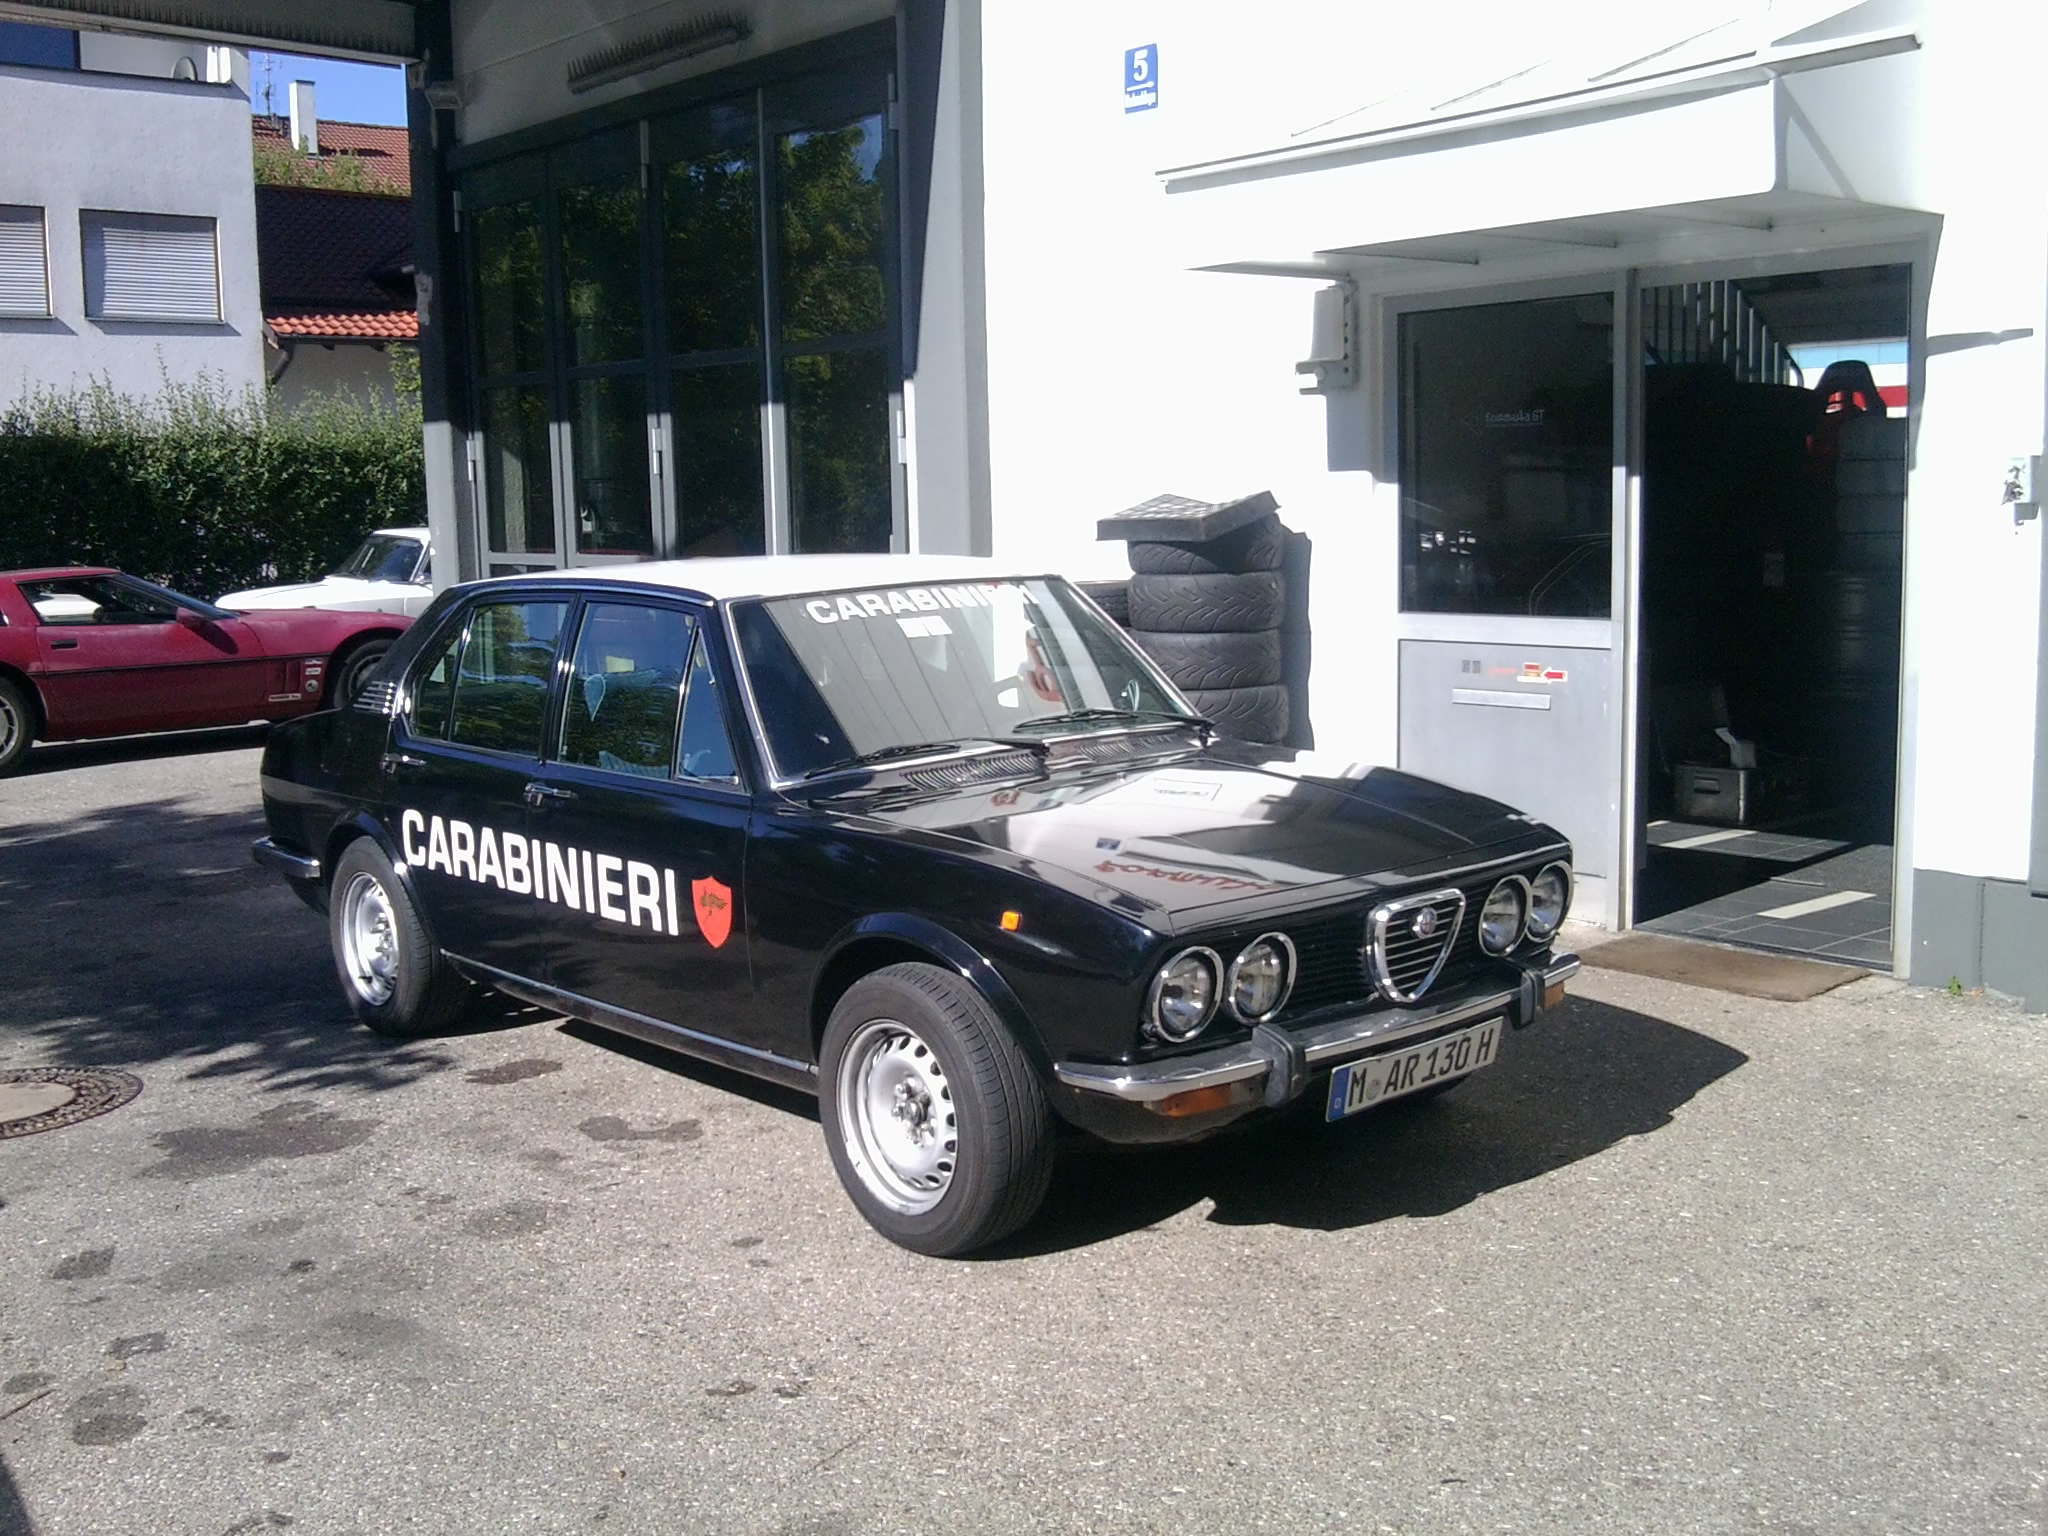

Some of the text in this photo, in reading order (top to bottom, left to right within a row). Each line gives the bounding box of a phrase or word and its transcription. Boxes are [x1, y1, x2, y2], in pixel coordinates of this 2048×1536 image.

[1133, 49, 1148, 81] 5
[402, 809, 679, 936] CARABINIERI
[1348, 1068, 1367, 1107] M
[1383, 1053, 1420, 1095] AR
[1476, 1028, 1494, 1064] H
